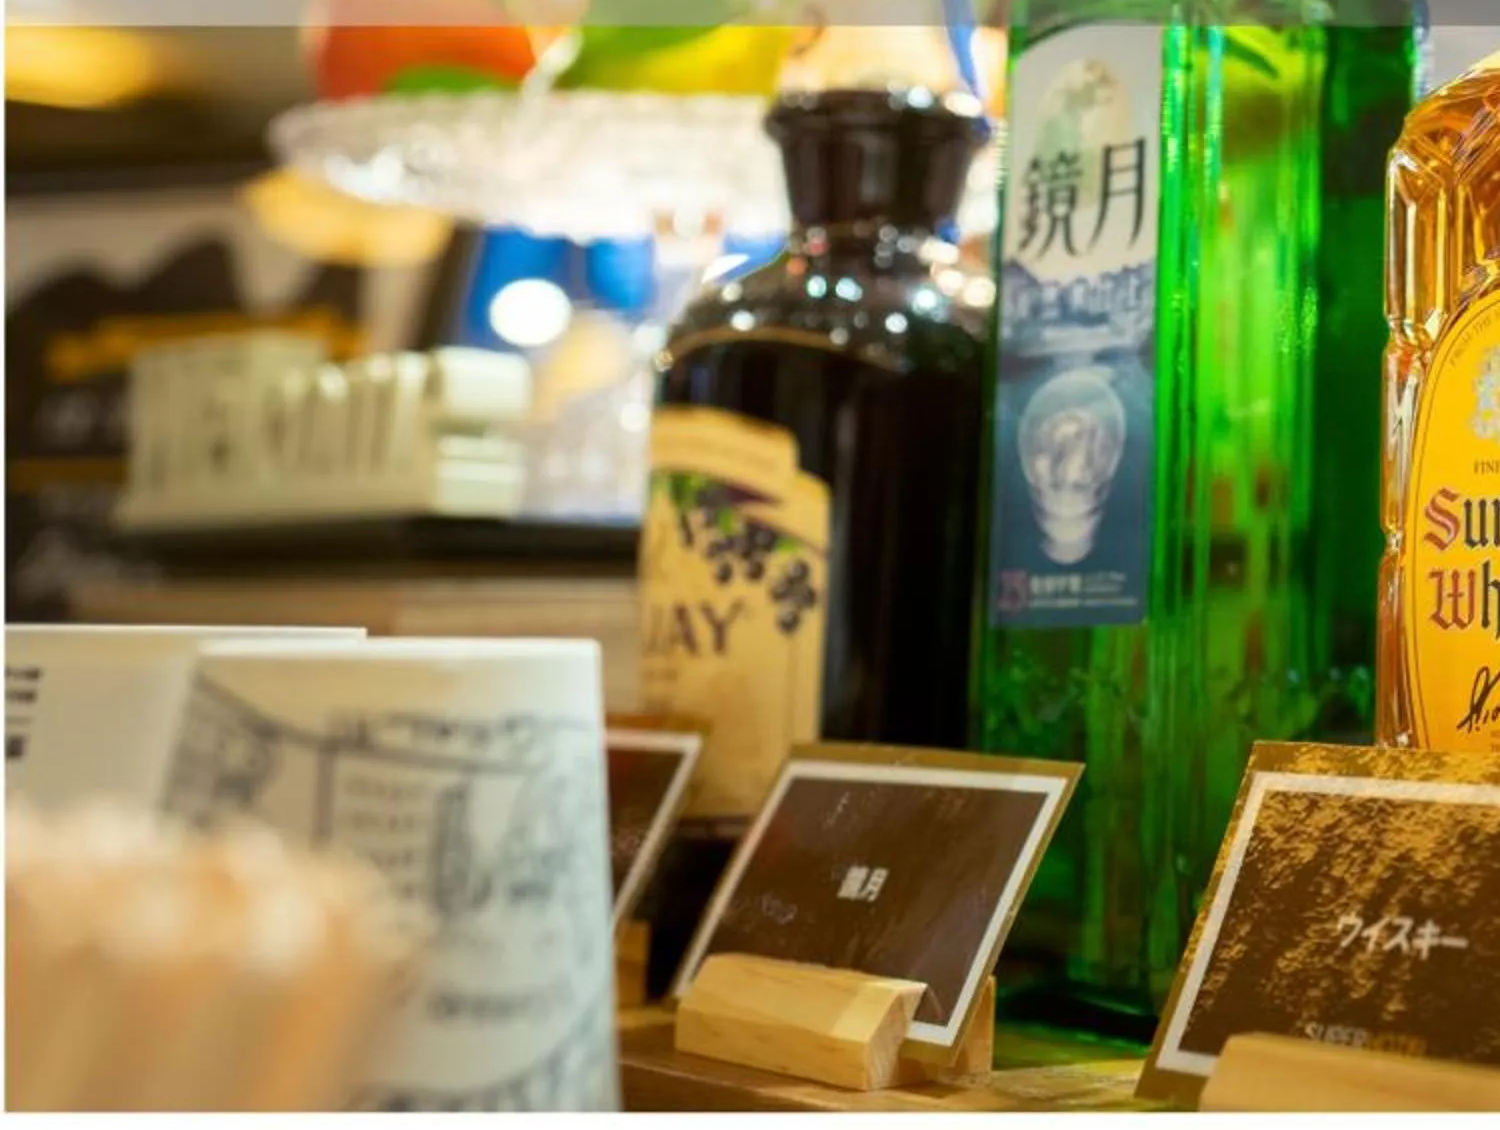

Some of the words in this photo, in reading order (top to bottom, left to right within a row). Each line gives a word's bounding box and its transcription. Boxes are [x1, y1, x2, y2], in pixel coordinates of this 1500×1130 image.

[1017, 136, 1147, 259] 鏡月
[1473, 460, 1500, 474] FINE
[1336, 912, 1469, 961] ウイスキー
